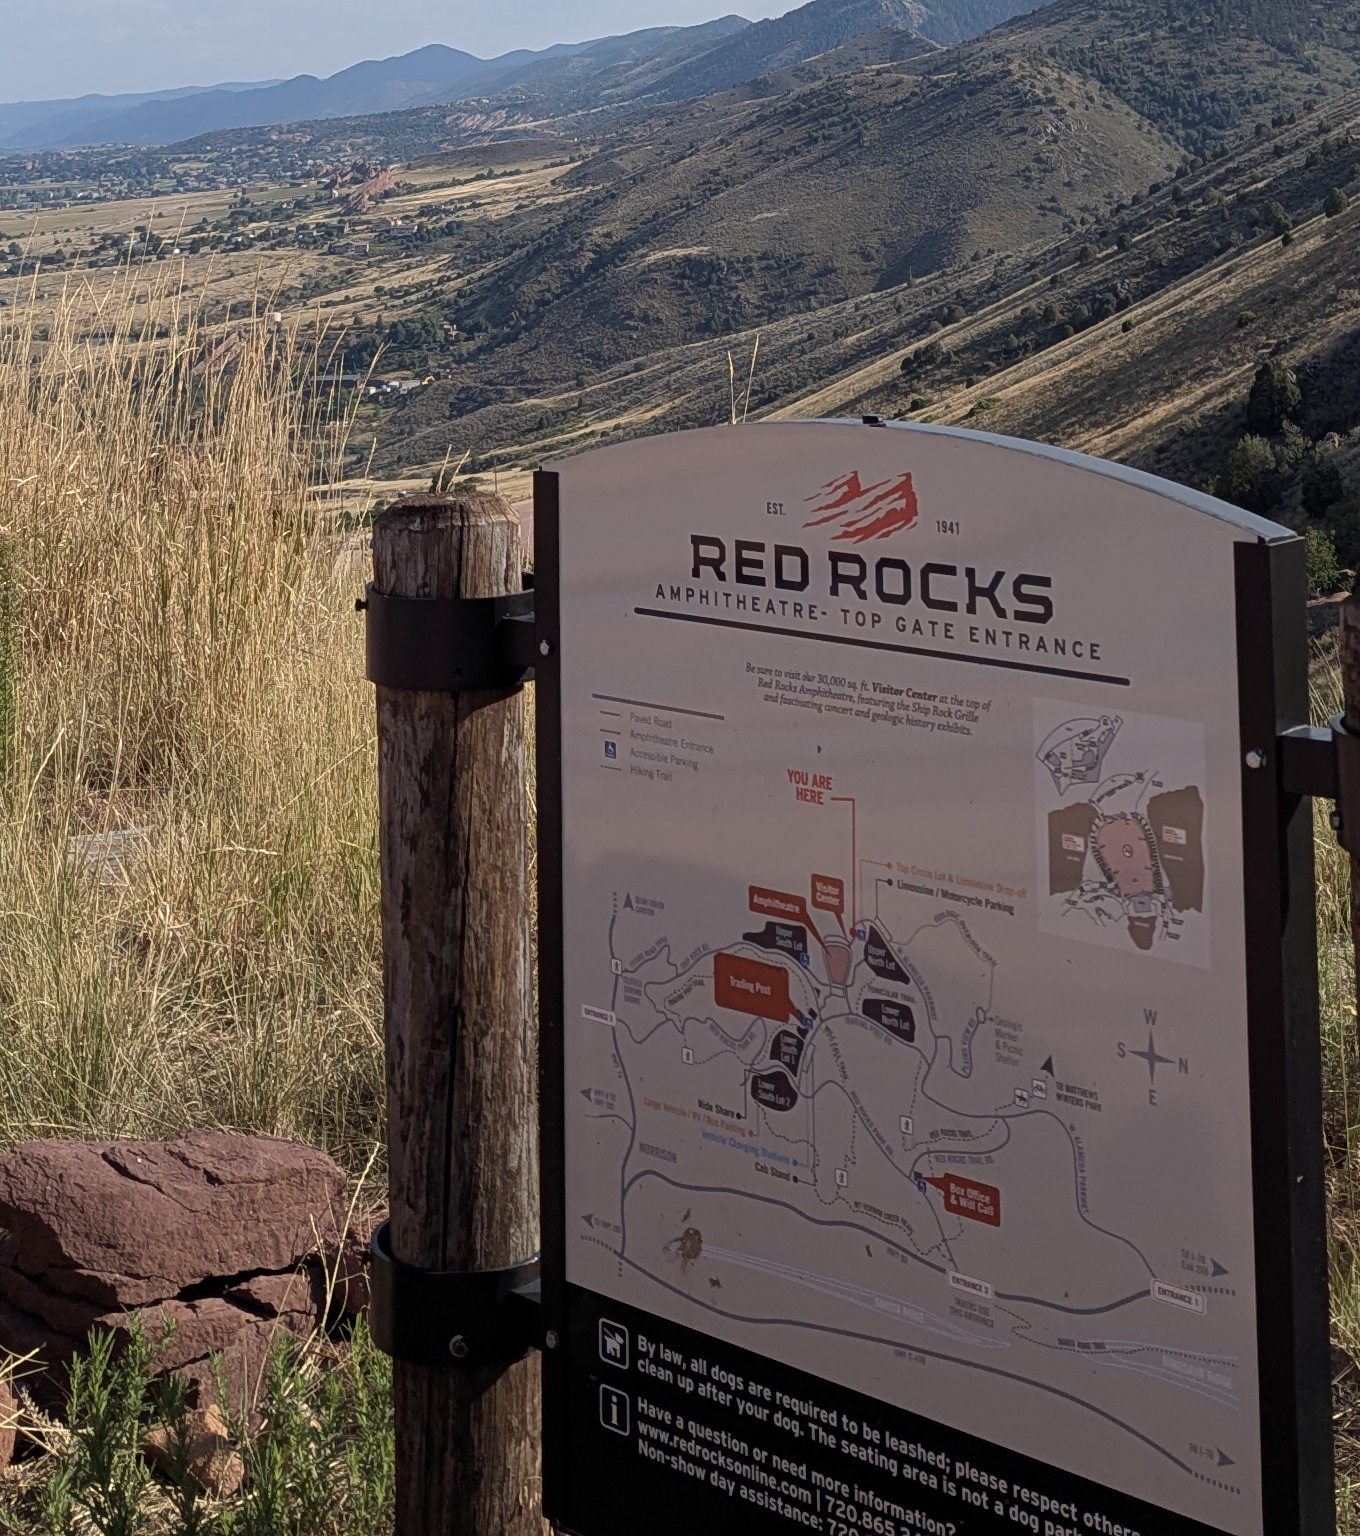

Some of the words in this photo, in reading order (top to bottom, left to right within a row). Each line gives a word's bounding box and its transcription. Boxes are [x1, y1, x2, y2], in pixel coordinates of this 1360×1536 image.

[766, 502, 786, 515] EST.
[936, 520, 960, 535] 1941
[691, 534, 809, 592] RED
[828, 550, 1053, 624] ROCKS
[841, 608, 881, 629] TOP
[895, 616, 954, 640] GATE
[969, 626, 1101, 661] ENTRANCE
[746, 662, 756, 673] Be
[757, 666, 773, 676] sure
[775, 668, 782, 677] to
[784, 670, 801, 681] visit
[802, 672, 816, 683] our
[817, 674, 846, 688] 30,000
[871, 682, 905, 697] Visitor
[905, 687, 938, 702] Center
[939, 695, 948, 704] at
[950, 694, 964, 707] the
[966, 698, 980, 711] top
[981, 700, 992, 713] of
[758, 677, 772, 689] Red
[775, 680, 797, 693] Rocks
[799, 684, 856, 704] Amphitheatre,
[857, 693, 895, 712] featuring
[897, 699, 910, 712] the
[912, 702, 931, 717] Ship
[932, 705, 953, 719] Rock
[954, 709, 979, 723] Grille
[630, 711, 652, 725] Paved
[653, 716, 672, 729] Road
[763, 693, 779, 704] and
[780, 693, 823, 714] fascinating
[824, 703, 853, 716] concert
[854, 708, 871, 719] and
[871, 711, 905, 726] geologic
[905, 714, 936, 732] history
[630, 729, 678, 747] Amphitheatre
[680, 739, 714, 755] Entrance
[630, 747, 669, 764] Accessible
[670, 755, 699, 772] Parking
[630, 765, 654, 781] Hiking
[656, 769, 673, 782] Trail
[787, 768, 809, 786] YOU
[812, 774, 833, 791] ARE
[795, 787, 824, 805] HERE
[815, 881, 840, 896] Visitor
[816, 891, 840, 906] Center
[897, 879, 934, 896] Limousine
[941, 888, 982, 907] Motorcycle
[985, 898, 1015, 916] Parking
[753, 894, 800, 914] Amphitheatre
[775, 926, 793, 937] Upper
[776, 936, 793, 948] South
[794, 940, 803, 951] Lot
[729, 975, 755, 993] Trading
[755, 982, 771, 995] Post
[881, 1003, 900, 1016] Lower
[1143, 1008, 1158, 1026] W
[881, 1015, 899, 1029] North
[899, 1020, 910, 1031] Lot
[1117, 1042, 1126, 1058] S
[1178, 1057, 1189, 1075] N
[758, 1078, 775, 1091] Lower
[758, 1089, 775, 1102] South
[776, 1093, 786, 1105] Lot
[786, 1097, 791, 1107] 2
[1148, 1088, 1157, 1106] E
[697, 1099, 713, 1113] Ride
[715, 1104, 735, 1118] Share
[639, 1141, 677, 1164] MORRISON
[755, 1161, 769, 1175] Cab
[770, 1166, 793, 1181] Stand
[950, 1182, 966, 1196] Box
[966, 1188, 991, 1204] Office
[950, 1195, 958, 1205] &
[959, 1196, 976, 1210] Will
[977, 1202, 995, 1216] Call
[952, 1276, 983, 1292] ENTRANCE
[984, 1287, 989, 1295] 2
[1157, 1286, 1194, 1305] ENTRANCE
[1194, 1298, 1199, 1307] 1
[638, 1334, 656, 1358] By
[659, 1343, 687, 1370] law,
[690, 1358, 707, 1376] all
[711, 1365, 744, 1391] dogs
[747, 1380, 772, 1401] are
[775, 1391, 838, 1427] required
[841, 1414, 859, 1435] to
[862, 1421, 881, 1444] be
[885, 1431, 950, 1475] leashed;
[955, 1461, 1008, 1494] please
[1013, 1484, 1078, 1522] respect
[637, 1358, 674, 1384] clean
[676, 1374, 694, 1393] up
[697, 1382, 733, 1407] after
[736, 1397, 770, 1422] your
[773, 1411, 804, 1438] dog.
[808, 1422, 837, 1449] The
[841, 1439, 898, 1477] seating
[902, 1463, 938, 1490] area
[942, 1474, 957, 1497] is
[961, 1486, 989, 1510] not
[994, 1500, 1004, 1516] a
[1009, 1504, 1039, 1533] dog
[637, 1420, 812, 1504] www.redrocksonline.com
[637, 1396, 672, 1425] Have
[675, 1415, 684, 1430] a
[688, 1420, 749, 1456] question
[753, 1447, 768, 1464] or
[772, 1454, 807, 1481] need
[811, 1470, 850, 1498] more
[854, 1484, 956, 1536] information?
[638, 1438, 706, 1481] Non-show
[710, 1470, 735, 1496] day
[740, 1484, 824, 1532] assistance:
